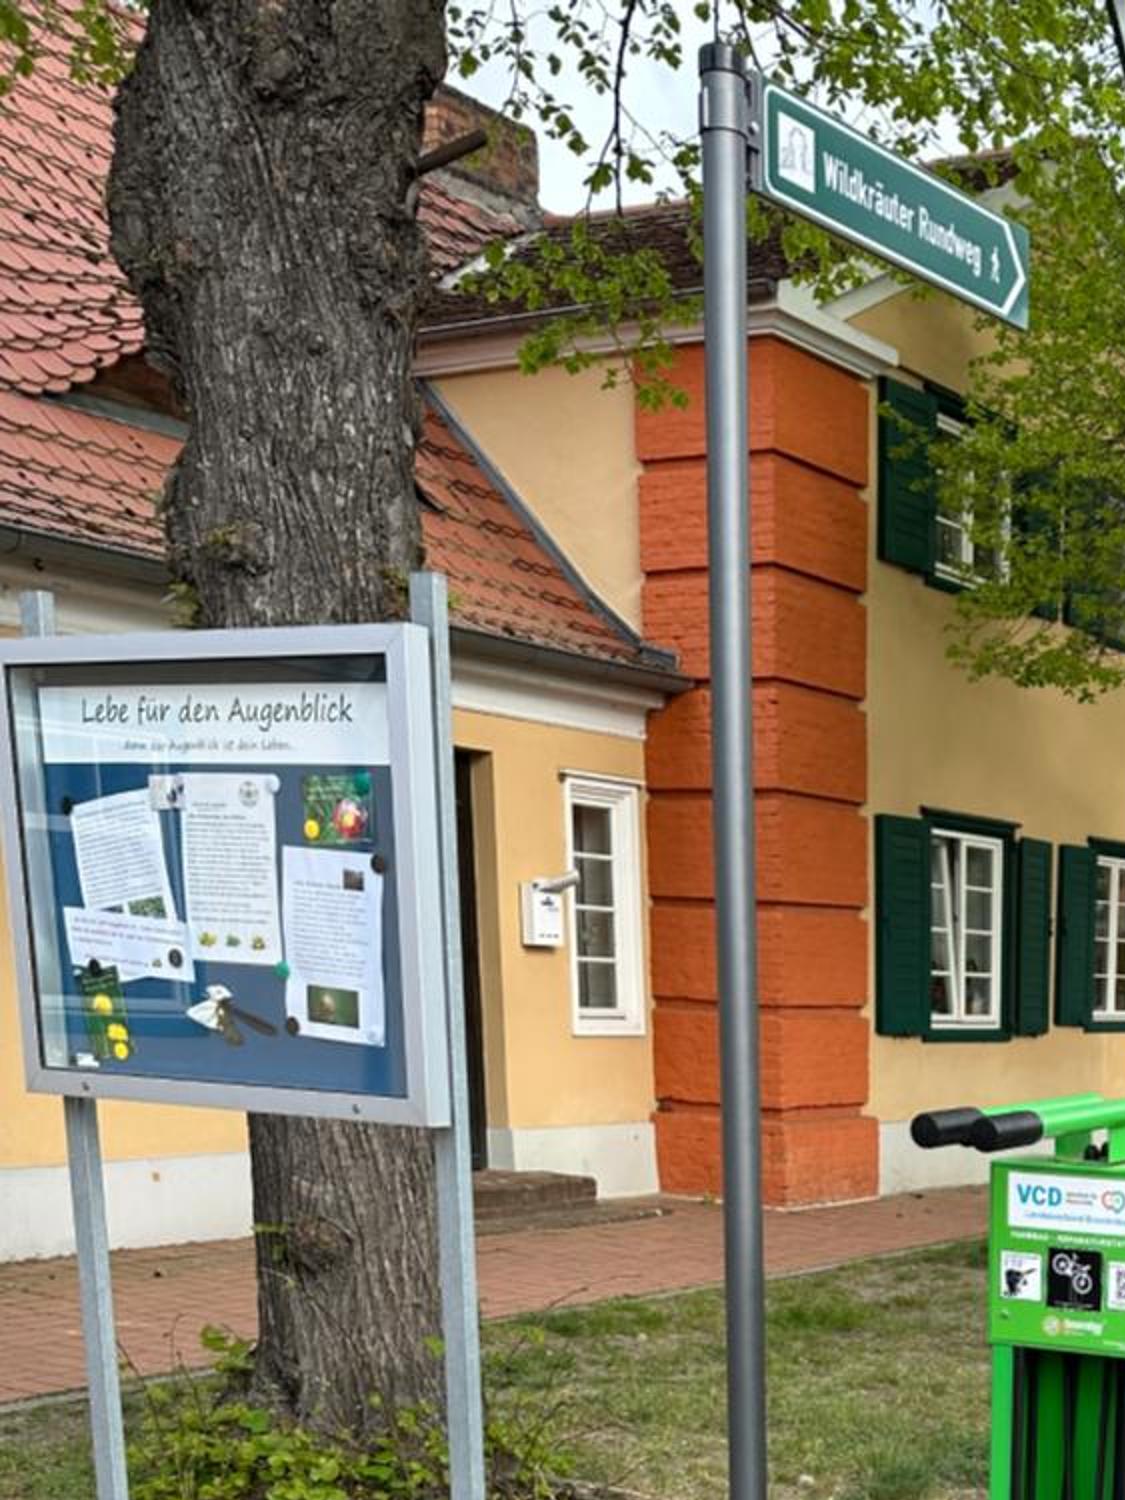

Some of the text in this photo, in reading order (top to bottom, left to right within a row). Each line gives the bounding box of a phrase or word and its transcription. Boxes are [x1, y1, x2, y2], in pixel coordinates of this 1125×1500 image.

[823, 150, 982, 277] Wildkräuter Rundweg
[81, 690, 353, 732] Lebe für den Augenblick
[1016, 1184, 1061, 1207] VCD
